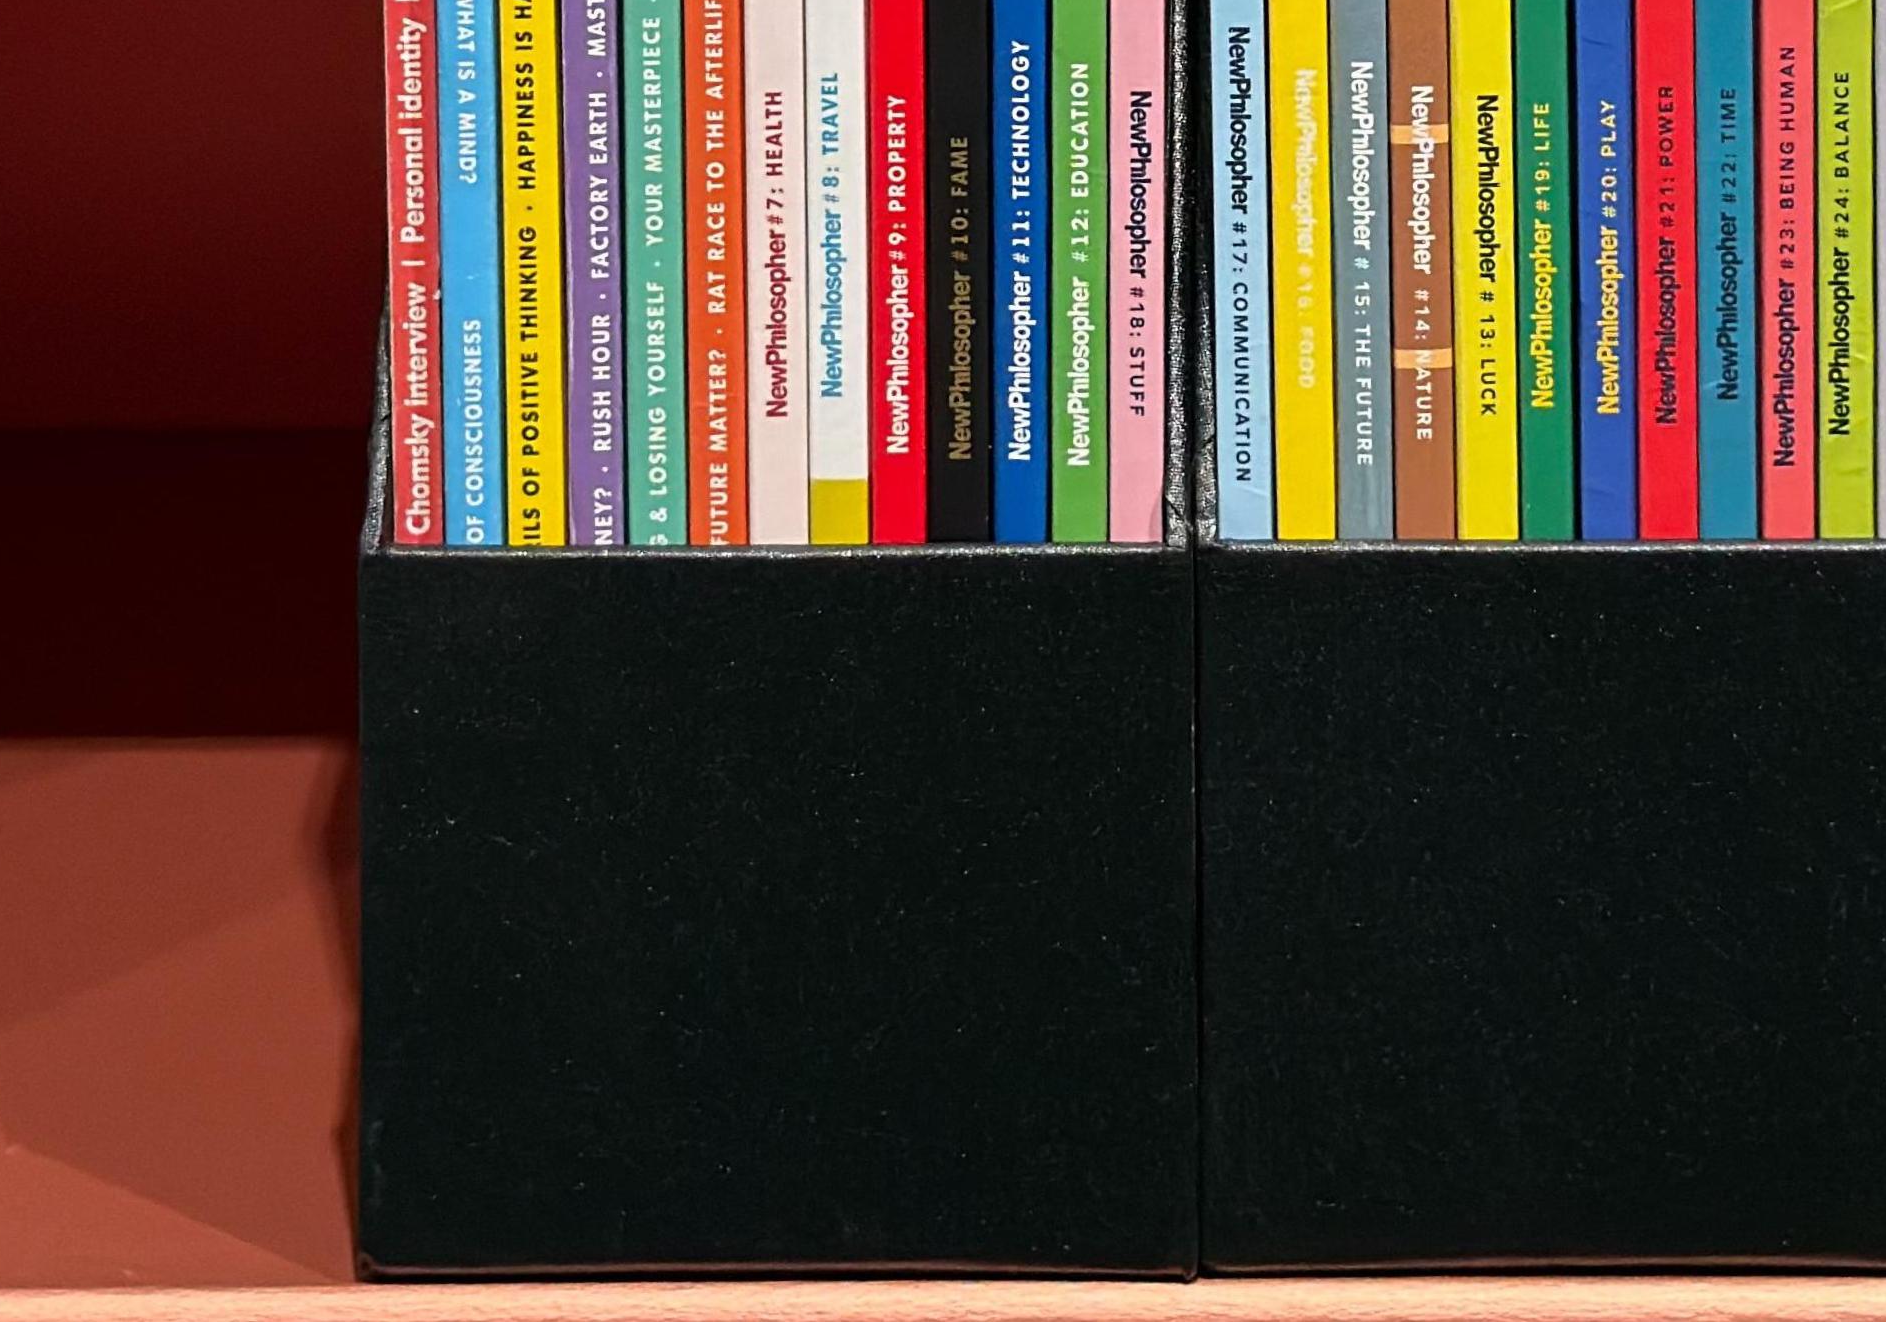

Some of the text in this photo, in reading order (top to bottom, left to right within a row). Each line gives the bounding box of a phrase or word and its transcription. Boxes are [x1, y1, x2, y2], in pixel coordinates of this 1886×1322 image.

[397, 18, 426, 118] identity
[458, 61, 475, 80] IS
[515, 32, 532, 50] IS
[458, 90, 475, 103] A
[516, 63, 535, 189] HAPPINESS
[589, 93, 607, 164] EARTH
[643, 18, 662, 172] MASTERPIECE
[706, 111, 724, 151] THE
[398, 128, 424, 242] Personal
[459, 113, 477, 183] MIND?
[705, 162, 724, 191] TO
[590, 176, 609, 278] FACTORY
[645, 184, 663, 246] YOUR
[706, 203, 725, 260] RACE
[765, 92, 791, 417] NewPhilosopher #7: HEALTH
[820, 73, 847, 397] NewPhilosopher #8: TRAVEL
[1008, 41, 1036, 460] NewPhilosopher #11: TECHNOLOGY
[1067, 63, 1094, 466] NewPhilosopher #12: EDUCATION
[1225, 27, 1252, 480] NewPhilosopher #17: COMMUNICATION
[1530, 104, 1557, 408] NewPhilosopher #19: LIFE
[1773, 48, 1799, 466] NewPhilosopher #23: BEING HUMAN
[519, 227, 537, 341] THINKING
[707, 272, 725, 313] RAT
[886, 96, 914, 454] NewPhilosopher #9: PROPERTY
[402, 283, 427, 406] interview
[592, 315, 610, 379] HOUR
[646, 282, 665, 396] YOURSELF
[463, 320, 484, 543] OF CONSCIOUSNESS
[521, 353, 539, 455] POSITIVE
[593, 391, 611, 451] RUSH
[708, 350, 726, 451] MATTER?
[404, 414, 434, 535] Chomsky
[522, 468, 539, 496] OF
[648, 408, 667, 495] LOSING
[523, 508, 541, 544] ILS
[650, 508, 667, 522] &
[709, 463, 729, 545] FUTURE
